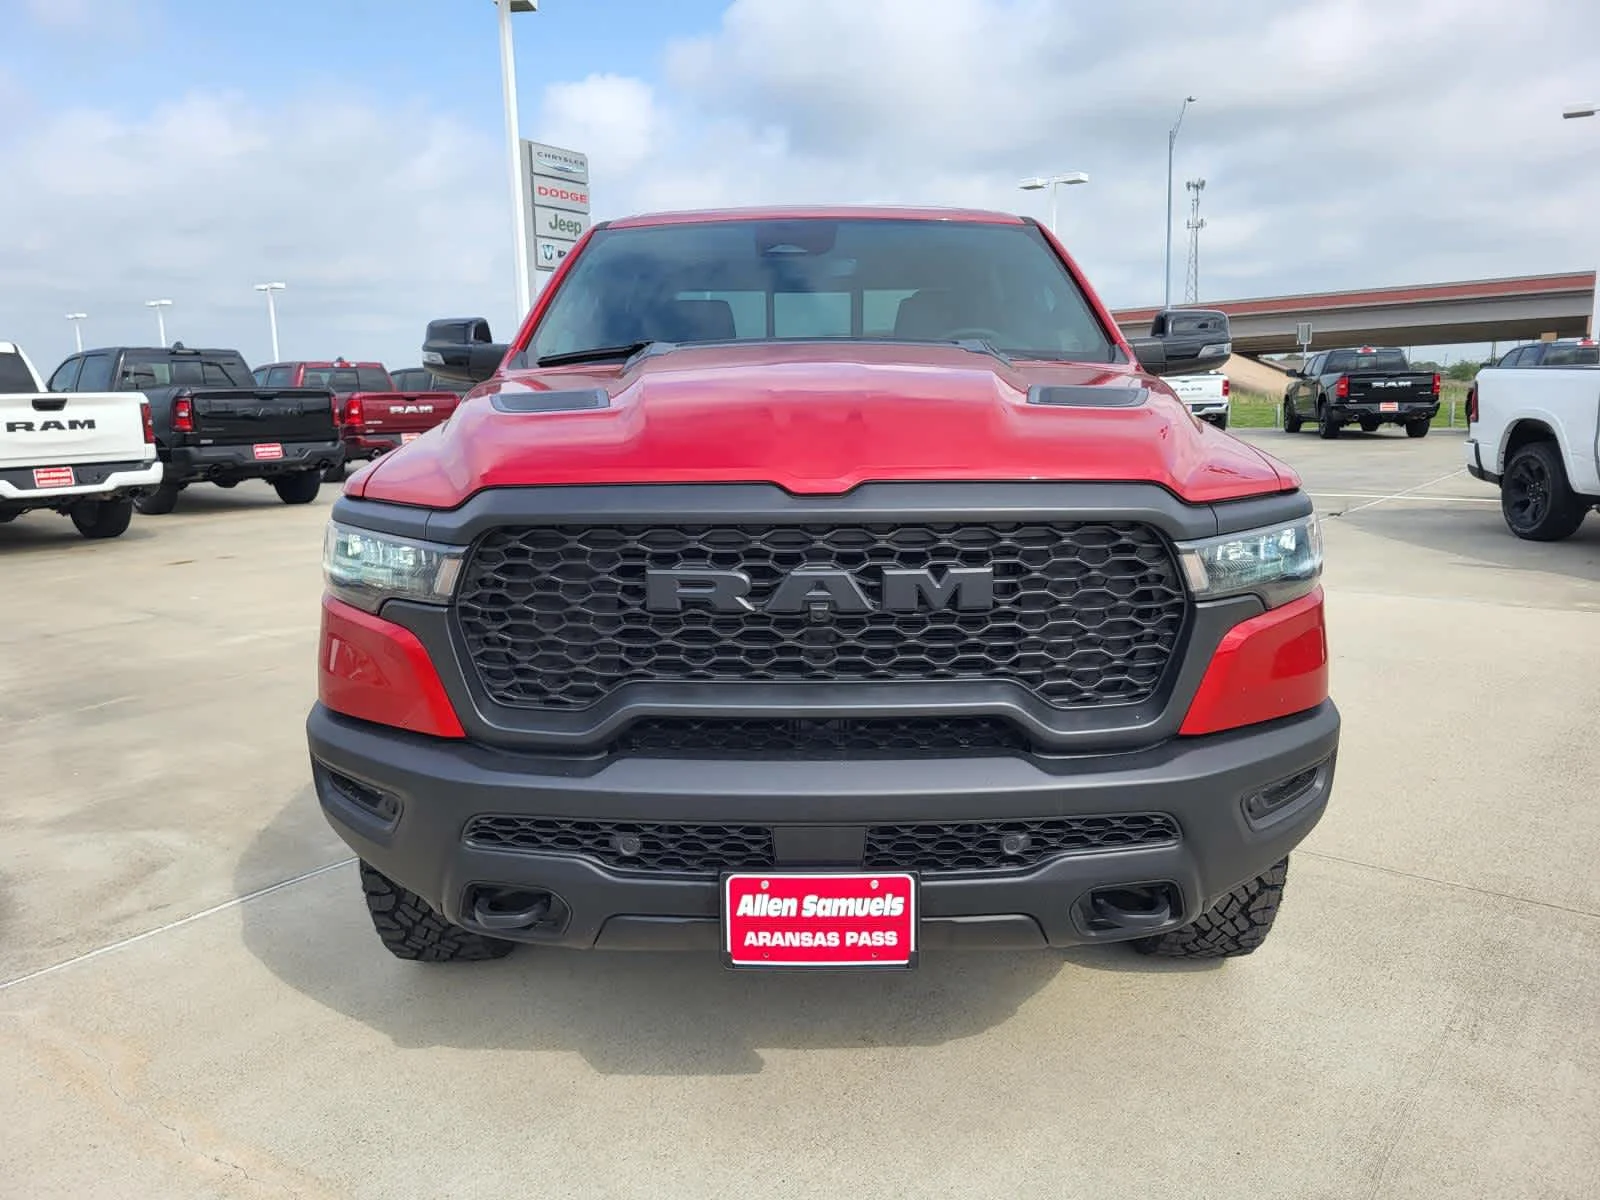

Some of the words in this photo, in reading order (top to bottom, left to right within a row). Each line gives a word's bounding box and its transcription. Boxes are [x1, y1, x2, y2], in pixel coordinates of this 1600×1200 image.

[537, 151, 585, 167] CHRYSLER
[537, 186, 588, 204] DODGE
[548, 213, 582, 235] Jeep
[389, 404, 434, 415] RAM
[6, 419, 96, 432] RAM
[646, 566, 993, 612] RAM
[736, 894, 798, 917] Allen
[801, 893, 905, 917] Samuels
[743, 931, 840, 947] ARANSAS
[845, 930, 899, 947] PASS
